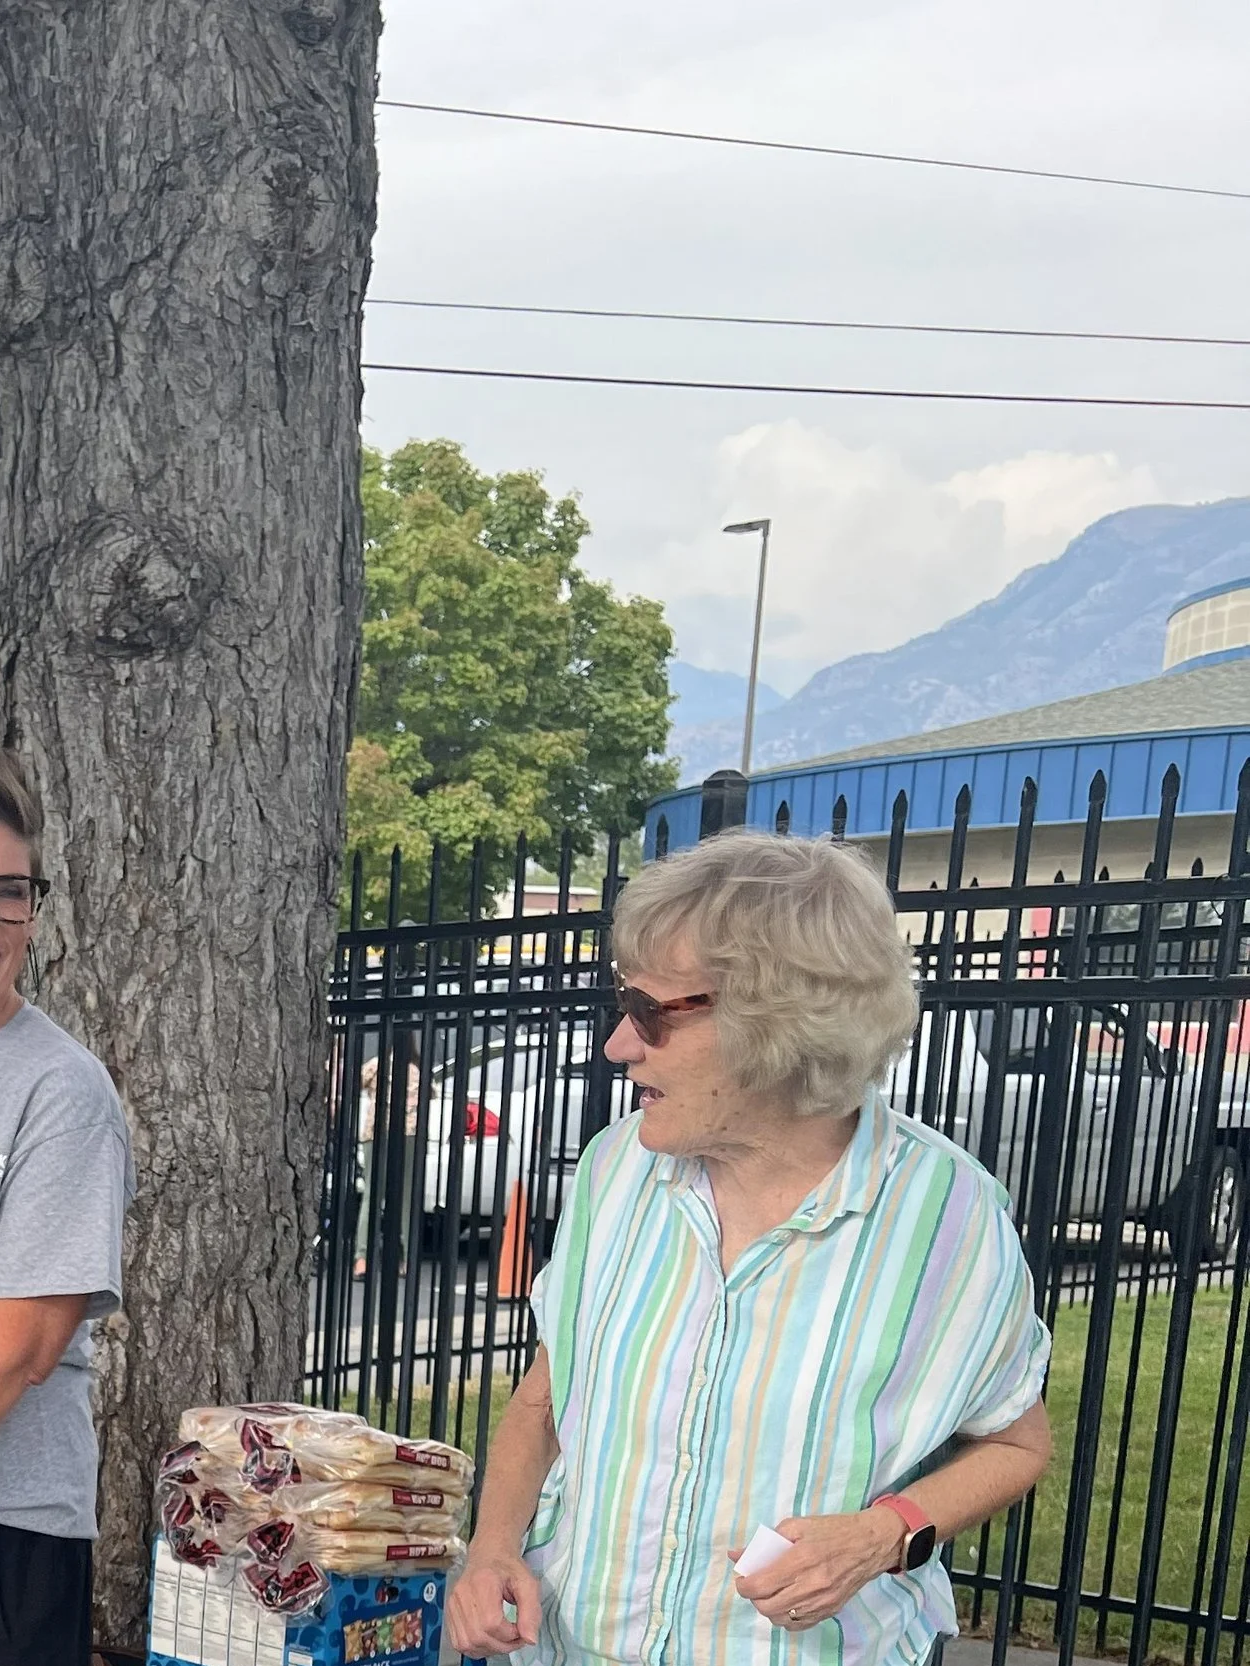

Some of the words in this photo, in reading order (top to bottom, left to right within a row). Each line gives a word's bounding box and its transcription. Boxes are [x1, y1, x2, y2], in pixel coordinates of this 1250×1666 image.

[416, 1452, 430, 1464] HOT
[431, 1454, 447, 1467] DOG
[409, 1547, 426, 1557] HOT
